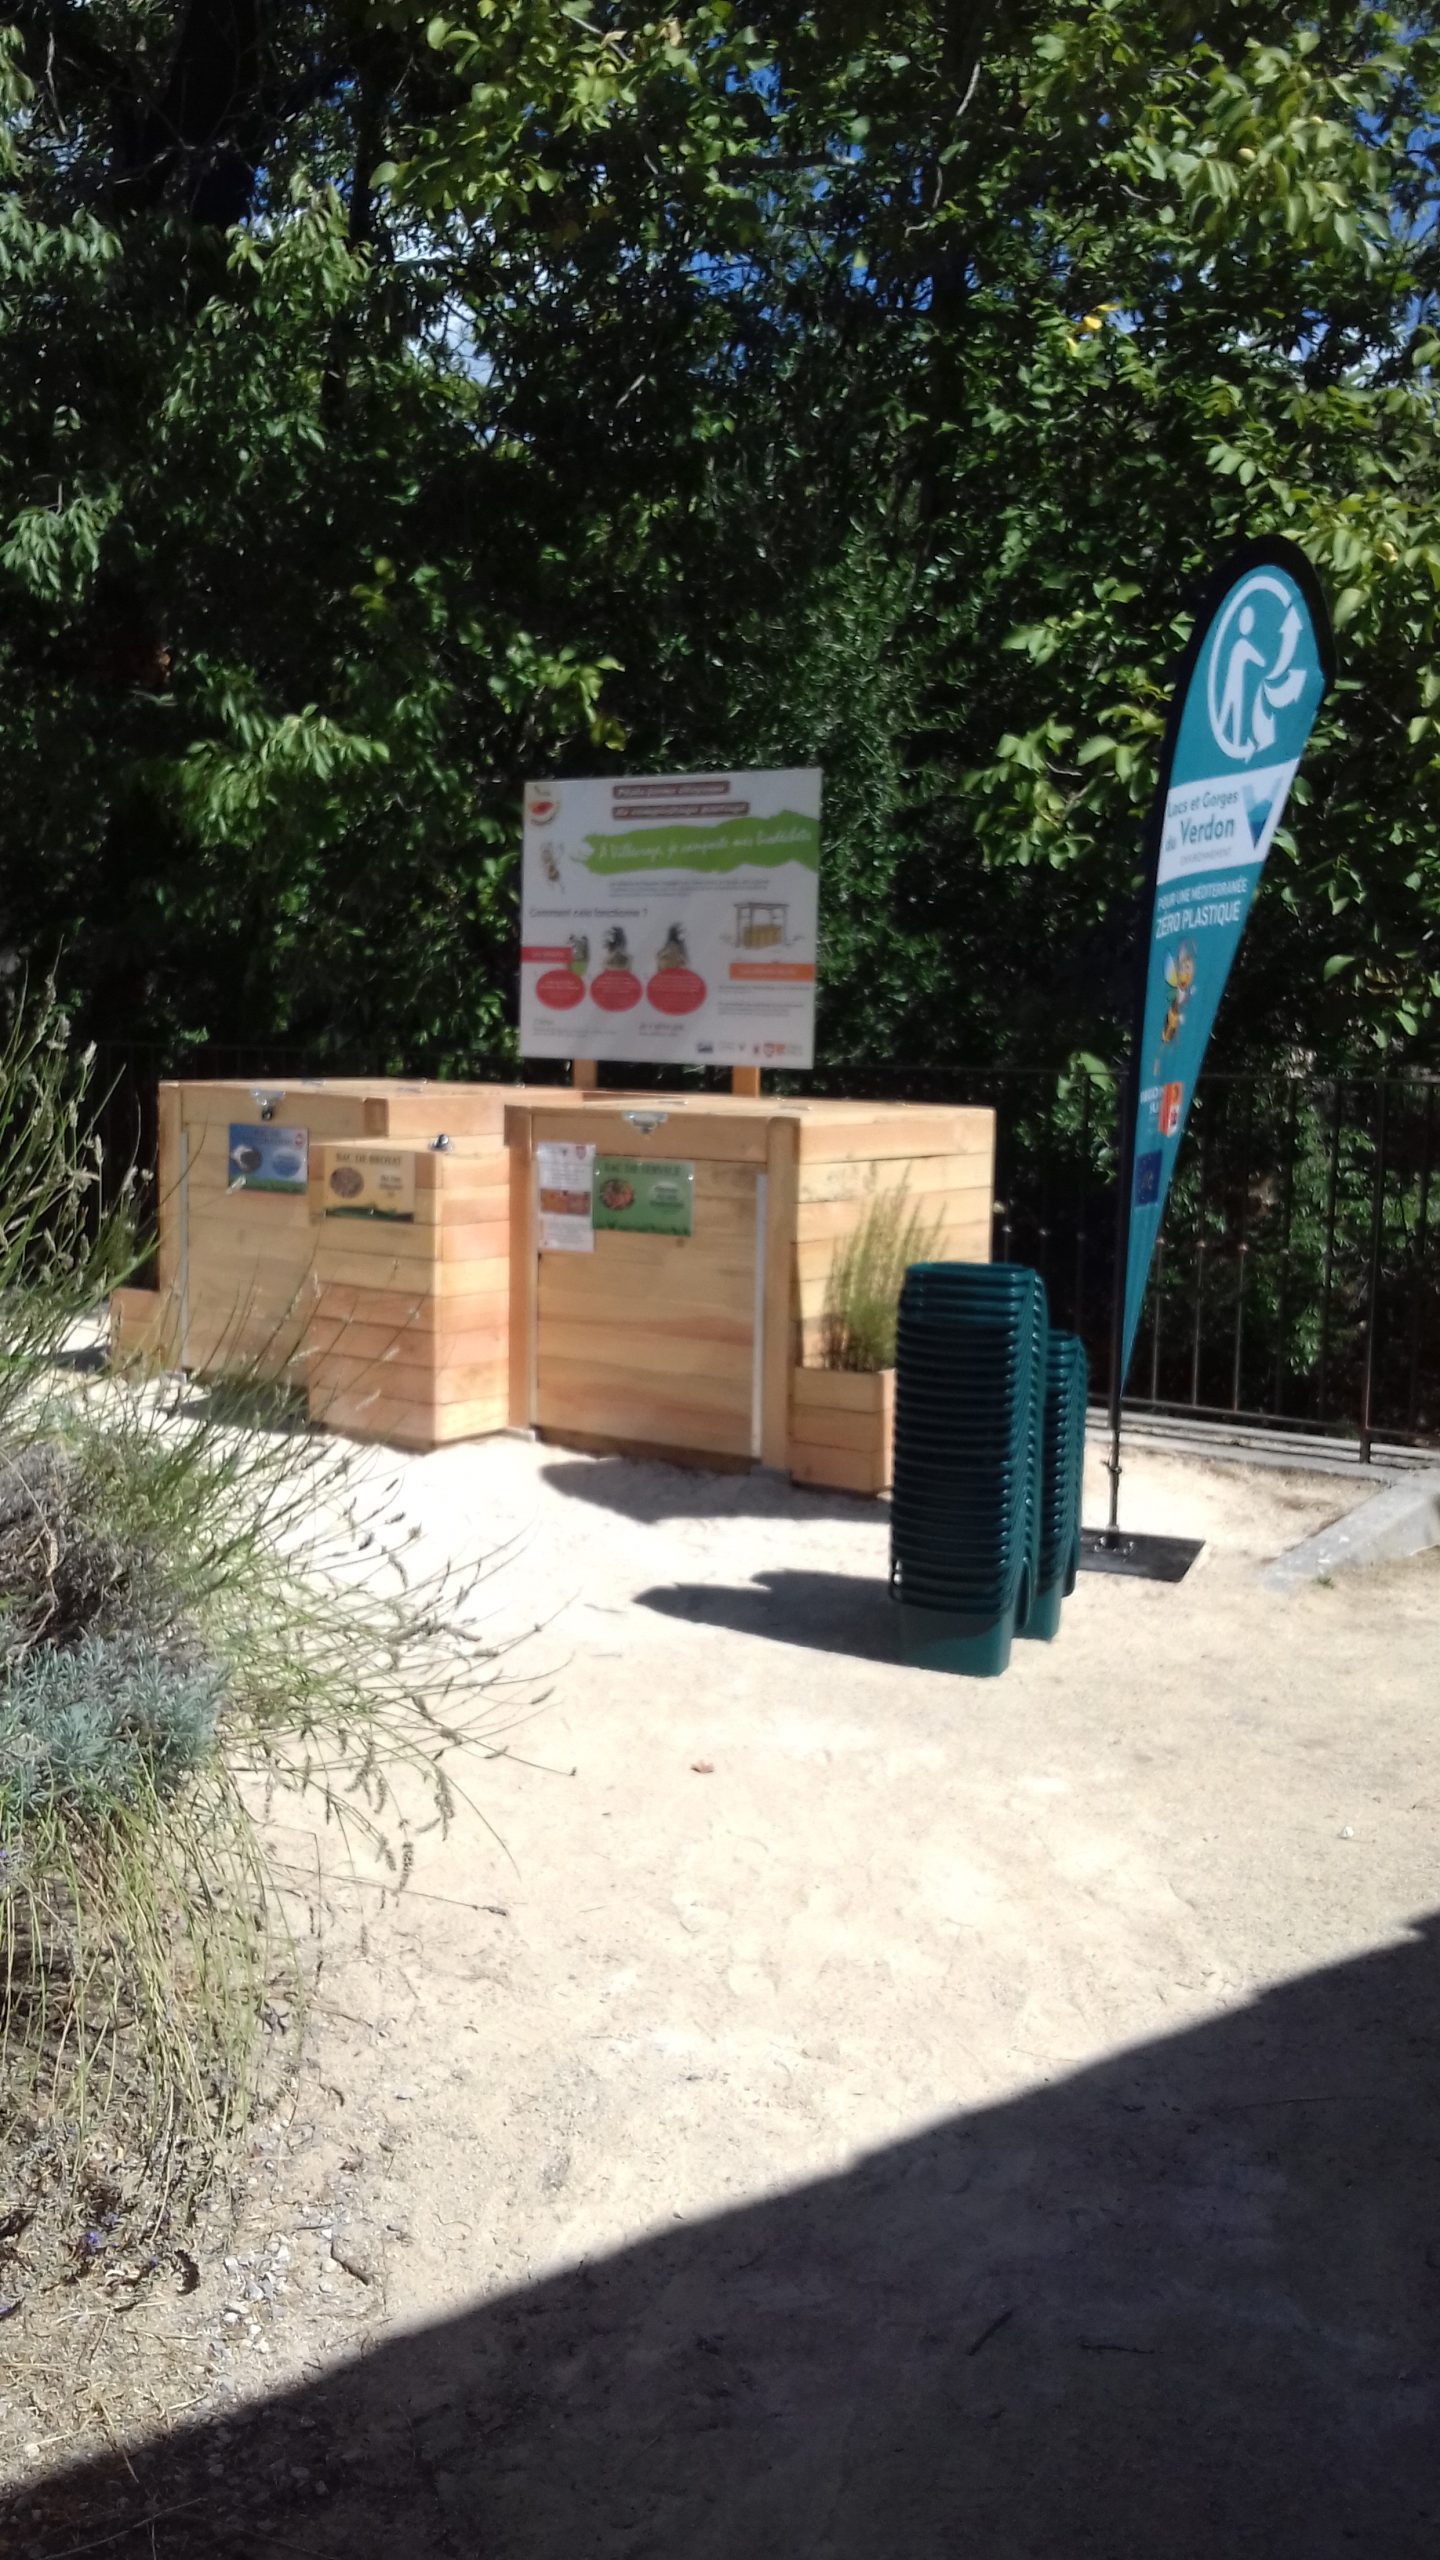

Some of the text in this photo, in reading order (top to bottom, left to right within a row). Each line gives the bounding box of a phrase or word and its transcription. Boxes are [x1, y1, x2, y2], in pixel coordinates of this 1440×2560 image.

[1190, 796, 1200, 811] et
[1203, 791, 1239, 809] Gorges
[1181, 814, 1234, 845] Verdon
[1157, 891, 1176, 912] POUR
[1177, 888, 1190, 904] UNE
[1182, 900, 1241, 929] PLASTIQUE
